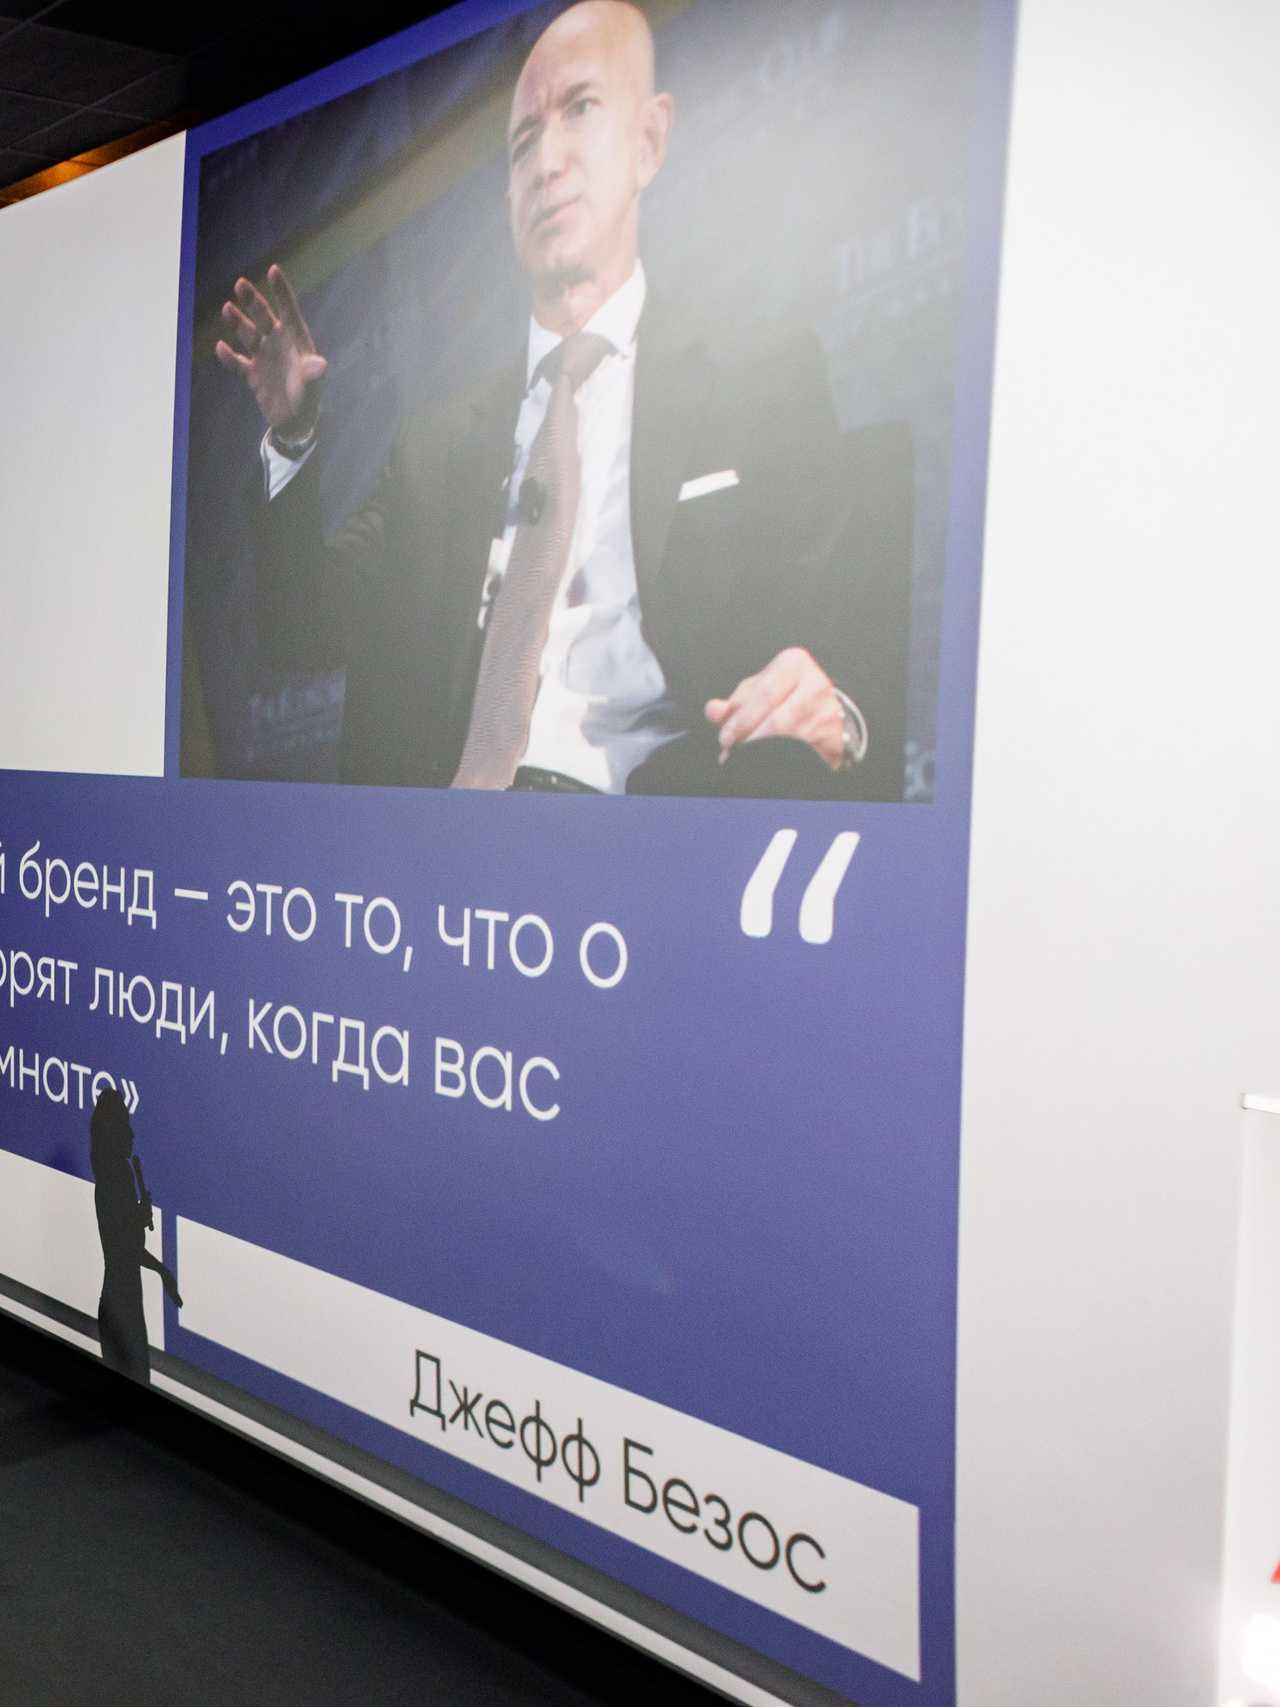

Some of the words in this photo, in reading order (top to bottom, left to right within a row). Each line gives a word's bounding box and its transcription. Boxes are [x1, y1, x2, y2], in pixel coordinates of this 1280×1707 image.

[19, 841, 157, 930] бренд
[226, 879, 317, 942] это
[334, 892, 414, 972] то,
[437, 904, 555, 978] что
[578, 920, 629, 990] о
[89, 967, 228, 1055] люди,
[248, 998, 410, 1091] когда
[434, 1036, 561, 1121] вас
[409, 1349, 601, 1503] Джефф
[623, 1437, 827, 1594] Безос
